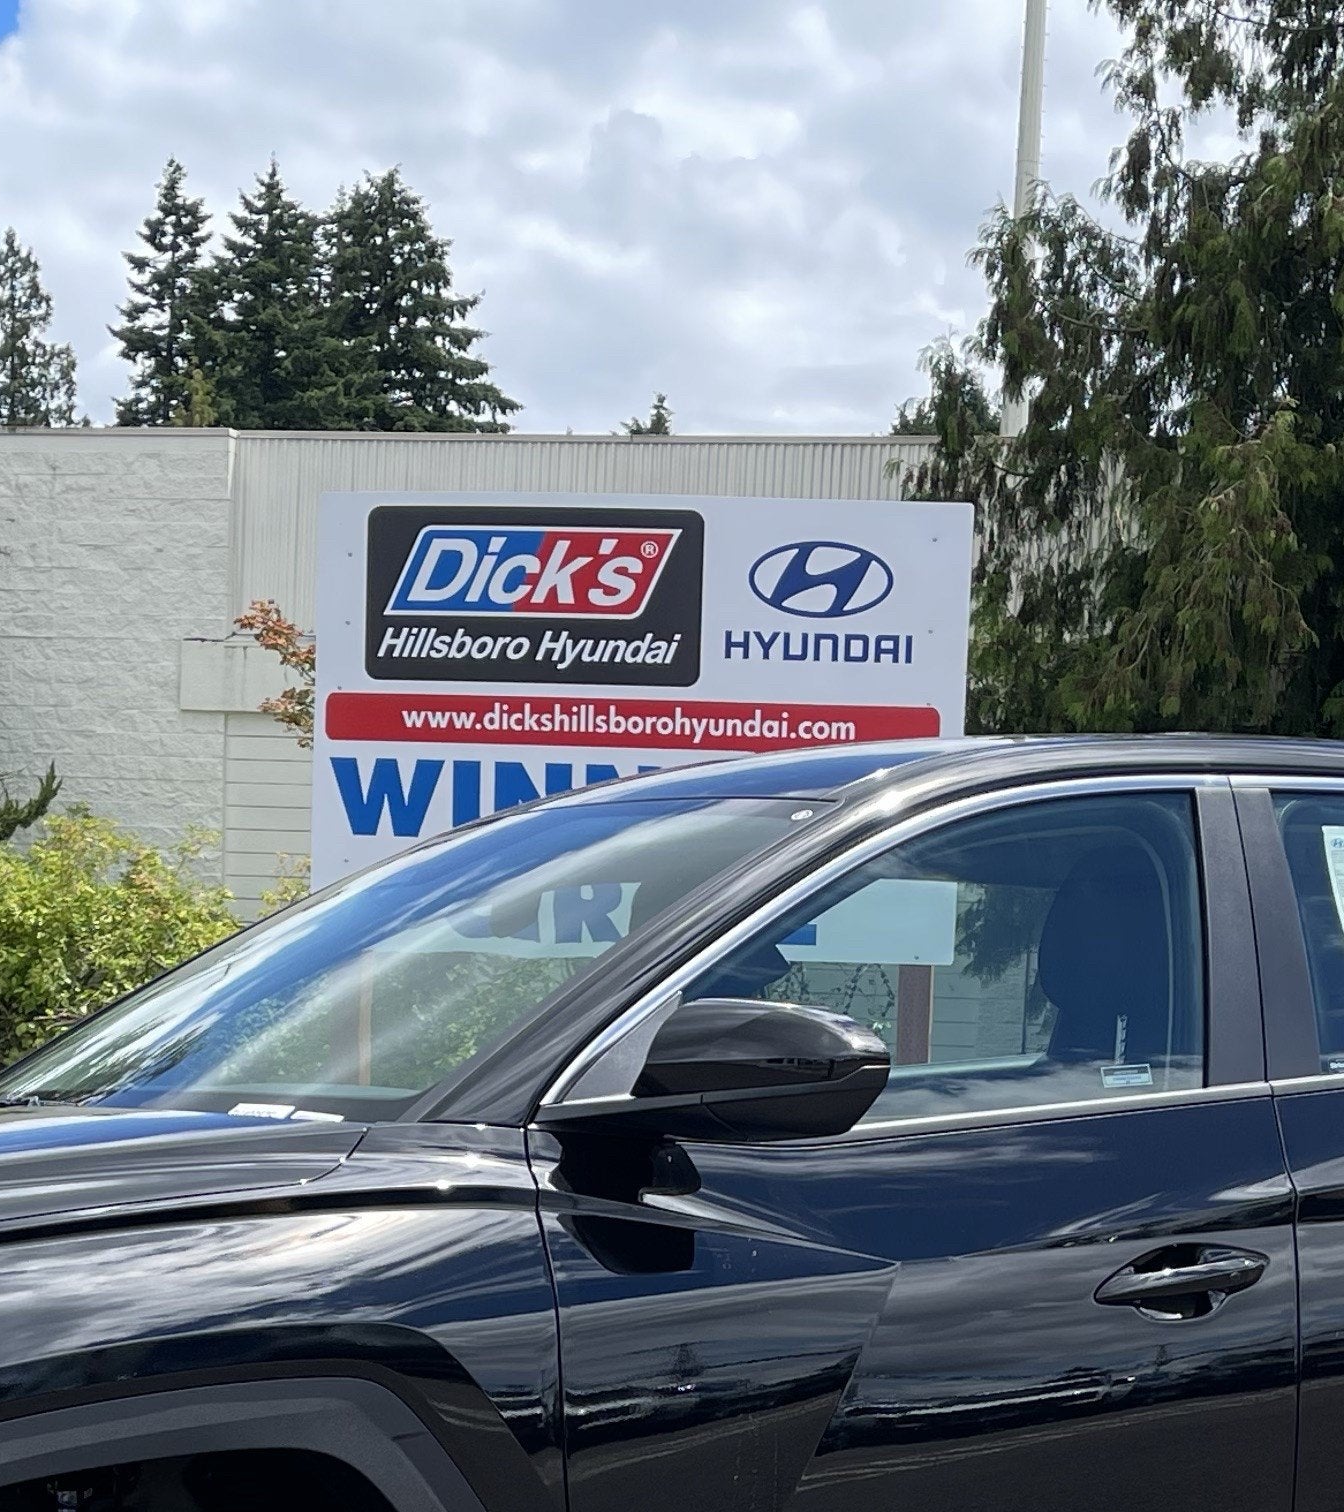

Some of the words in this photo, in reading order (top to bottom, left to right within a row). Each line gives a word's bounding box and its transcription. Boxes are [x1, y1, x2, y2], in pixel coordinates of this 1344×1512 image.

[377, 627, 530, 661] Hillsboro
[535, 630, 682, 671] Hyundai
[724, 630, 913, 664] HYUNDAI
[402, 702, 856, 744] www.dickshillsborohyundai.com
